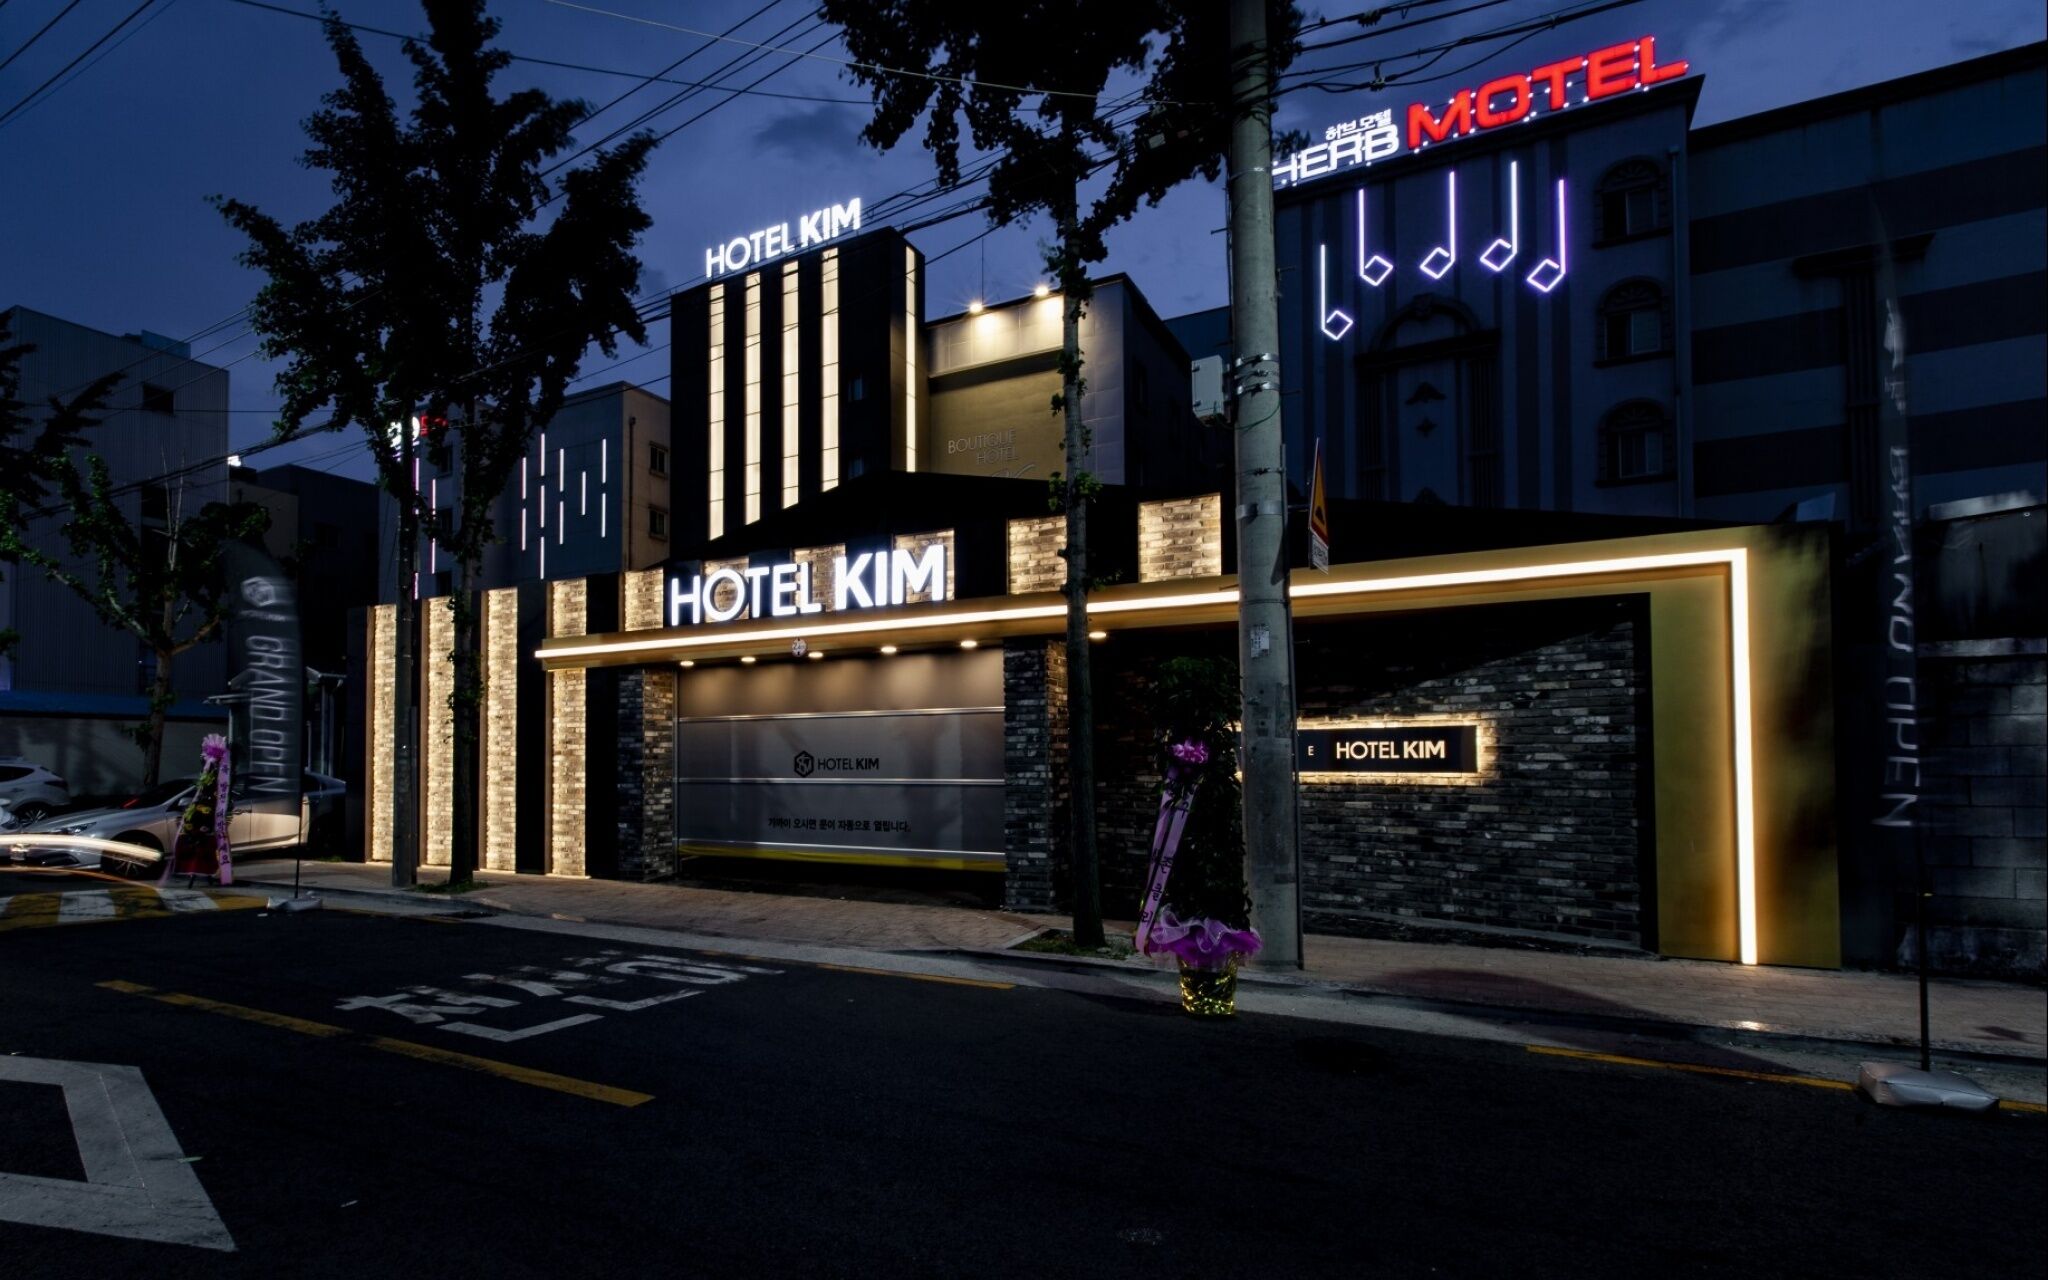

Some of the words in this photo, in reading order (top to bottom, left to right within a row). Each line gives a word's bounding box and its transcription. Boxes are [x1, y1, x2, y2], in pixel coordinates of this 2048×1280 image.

[1406, 34, 1690, 151] MOTEL
[1325, 120, 1360, 141] 허브
[1359, 108, 1392, 130] 모텔
[705, 222, 796, 279] HOTEL
[800, 197, 861, 248] KIM
[947, 427, 1017, 455] BOUTIQUE
[977, 446, 1019, 465] HOTEL
[671, 561, 823, 627] HOTEL
[834, 544, 945, 611] KIM
[246, 635, 294, 721] GRAND
[247, 727, 294, 793] OPEN
[817, 758, 853, 770] HOTEL
[855, 758, 880, 770] KIM
[1336, 741, 1400, 760] HOTEL
[1403, 740, 1447, 760] KIM
[768, 817, 791, 829] 가까이
[793, 818, 817, 830] 오시면
[819, 818, 835, 831] 문이
[838, 819, 871, 831] 자동으로
